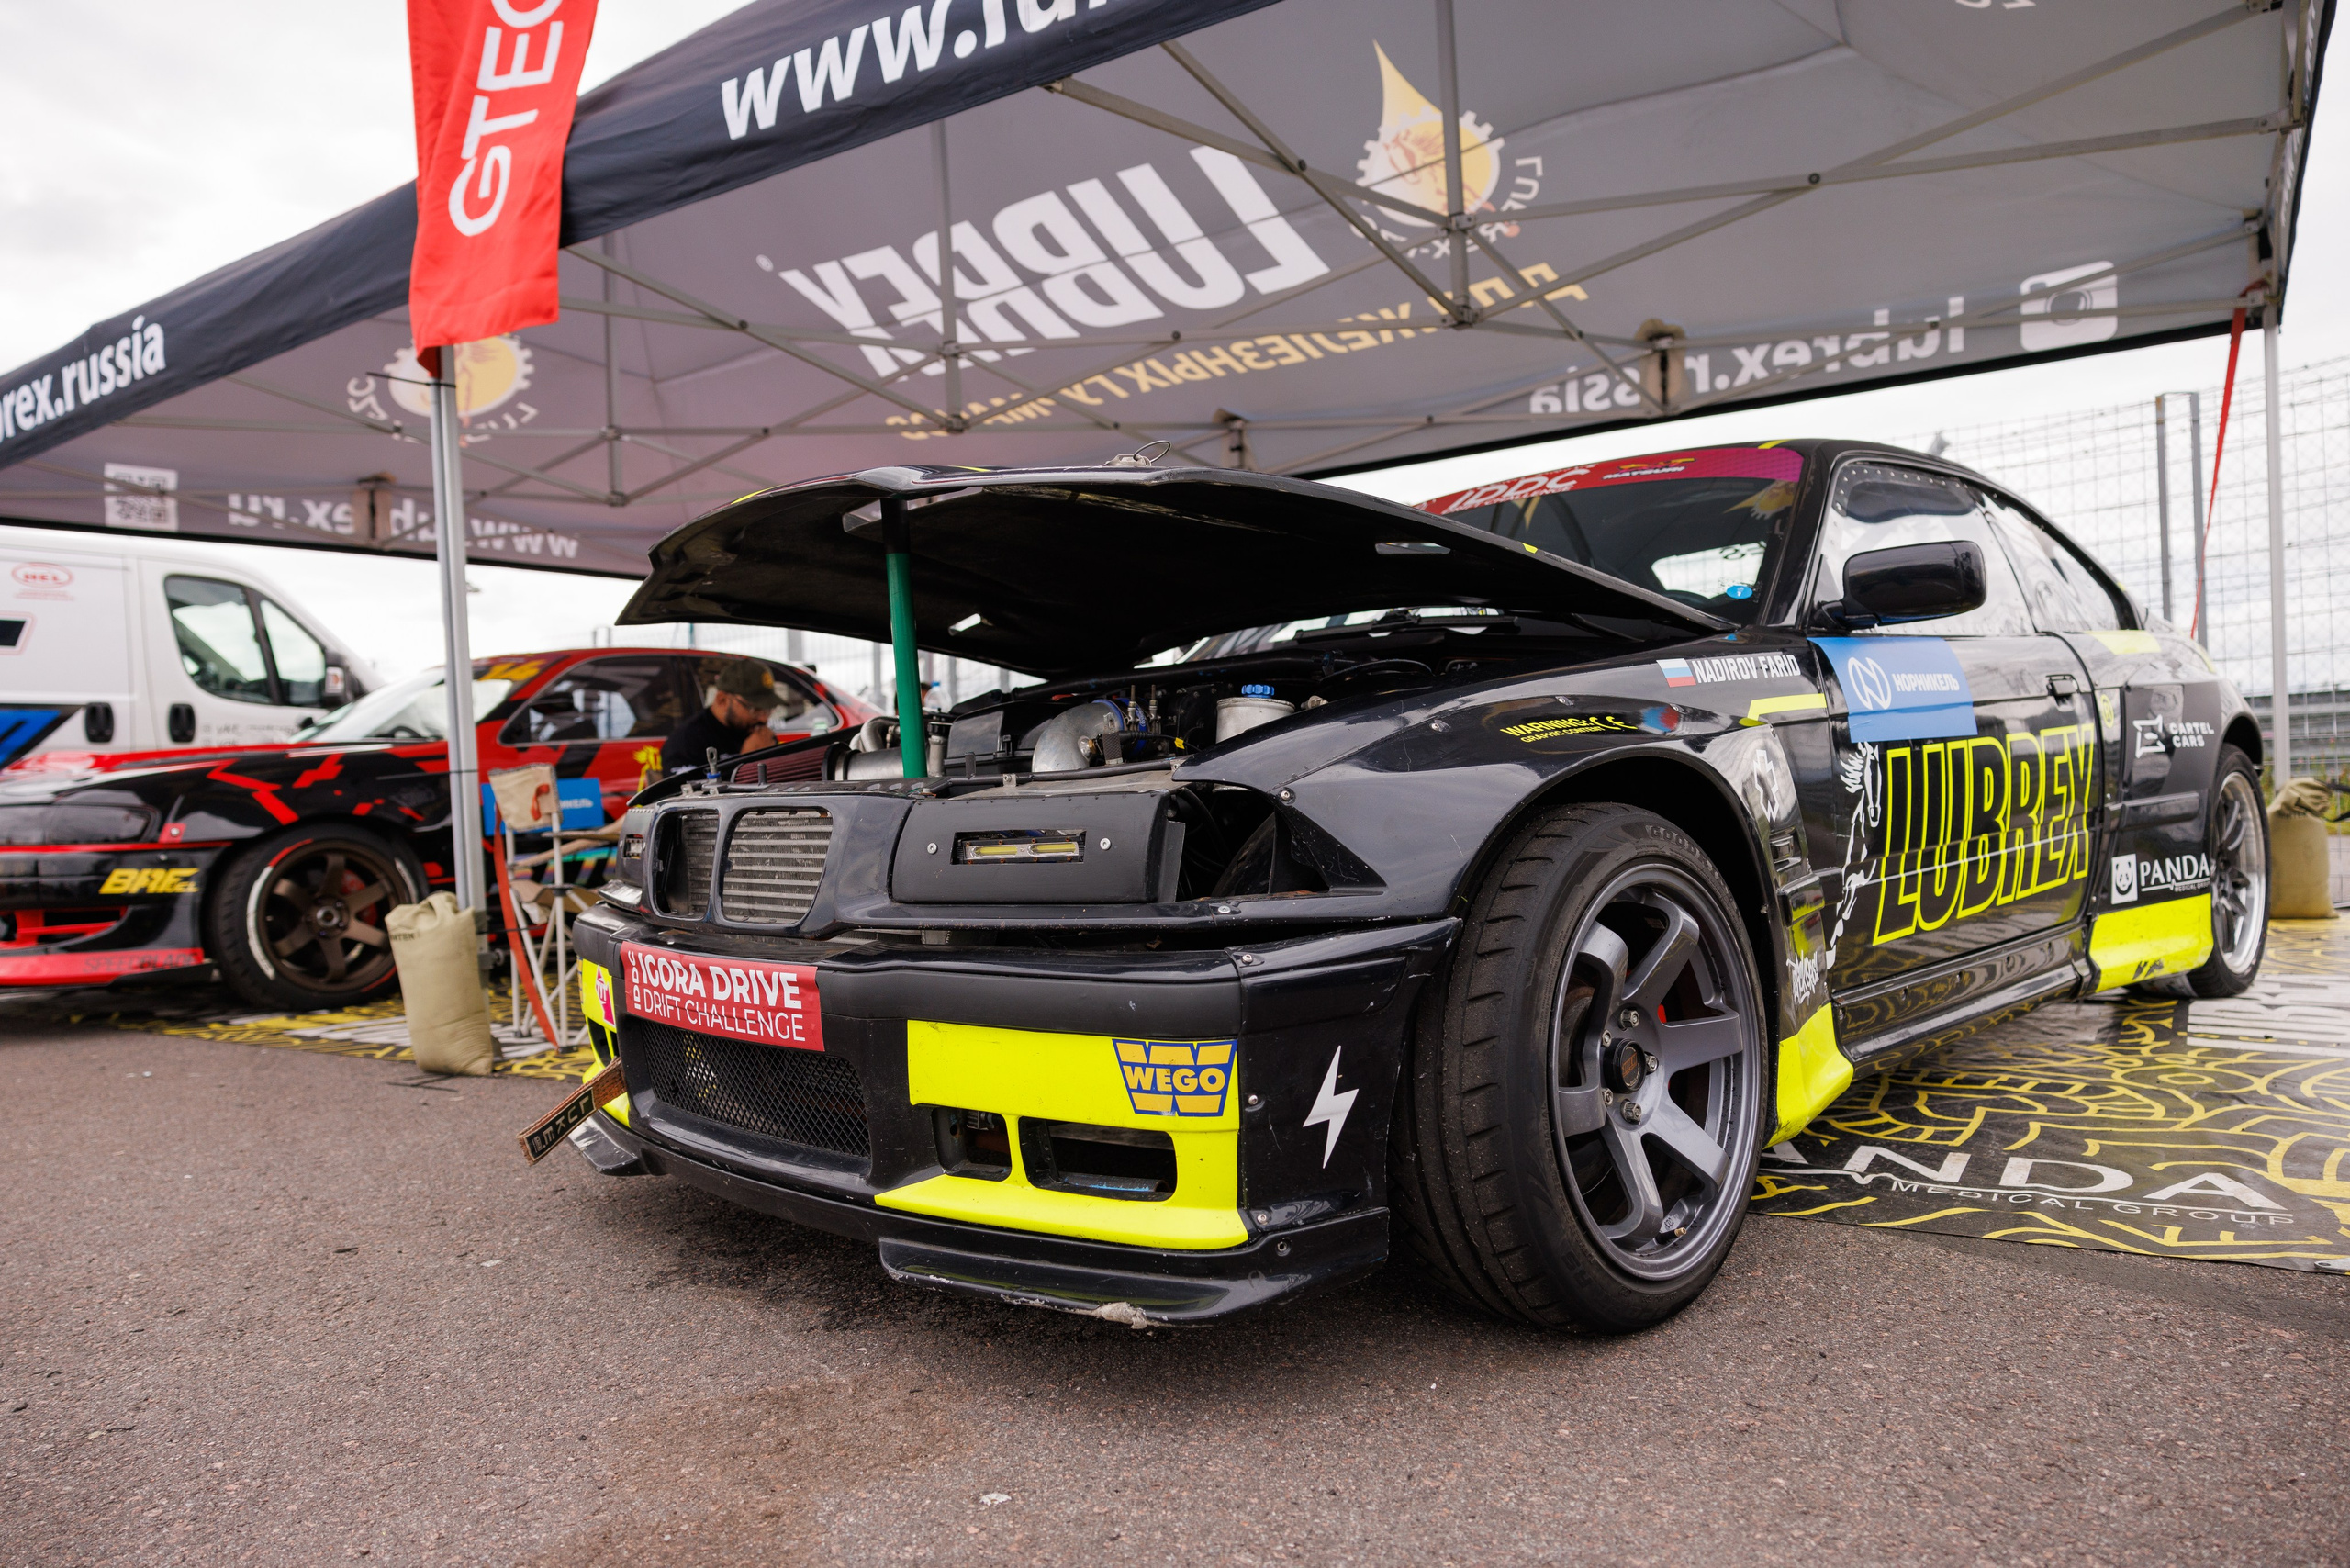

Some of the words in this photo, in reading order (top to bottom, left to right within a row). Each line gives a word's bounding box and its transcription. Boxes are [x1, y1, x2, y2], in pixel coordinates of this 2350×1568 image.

[722, 0, 1103, 140] www.lu
[0, 315, 166, 443] rex.russia
[1692, 656, 1759, 684] NADIROV
[1757, 654, 1801, 678] FARID
[1892, 673, 1960, 692] НОРНИКЕЛЬ
[2168, 722, 2215, 734] CARTEL
[2172, 734, 2205, 748] CARS
[1873, 722, 2095, 946] LUBREX
[2139, 852, 2210, 887] PANDA
[627, 949, 642, 1010] IDDC
[637, 951, 707, 999] IGORA
[709, 965, 803, 1010] DRIVE
[643, 988, 681, 1021] DRIFT
[684, 999, 806, 1042] CHALLENGE
[1122, 1064, 1226, 1093] WEGO
[1890, 1180, 2094, 1211] MEDICAL
[2112, 1204, 2295, 1226] GROUP
